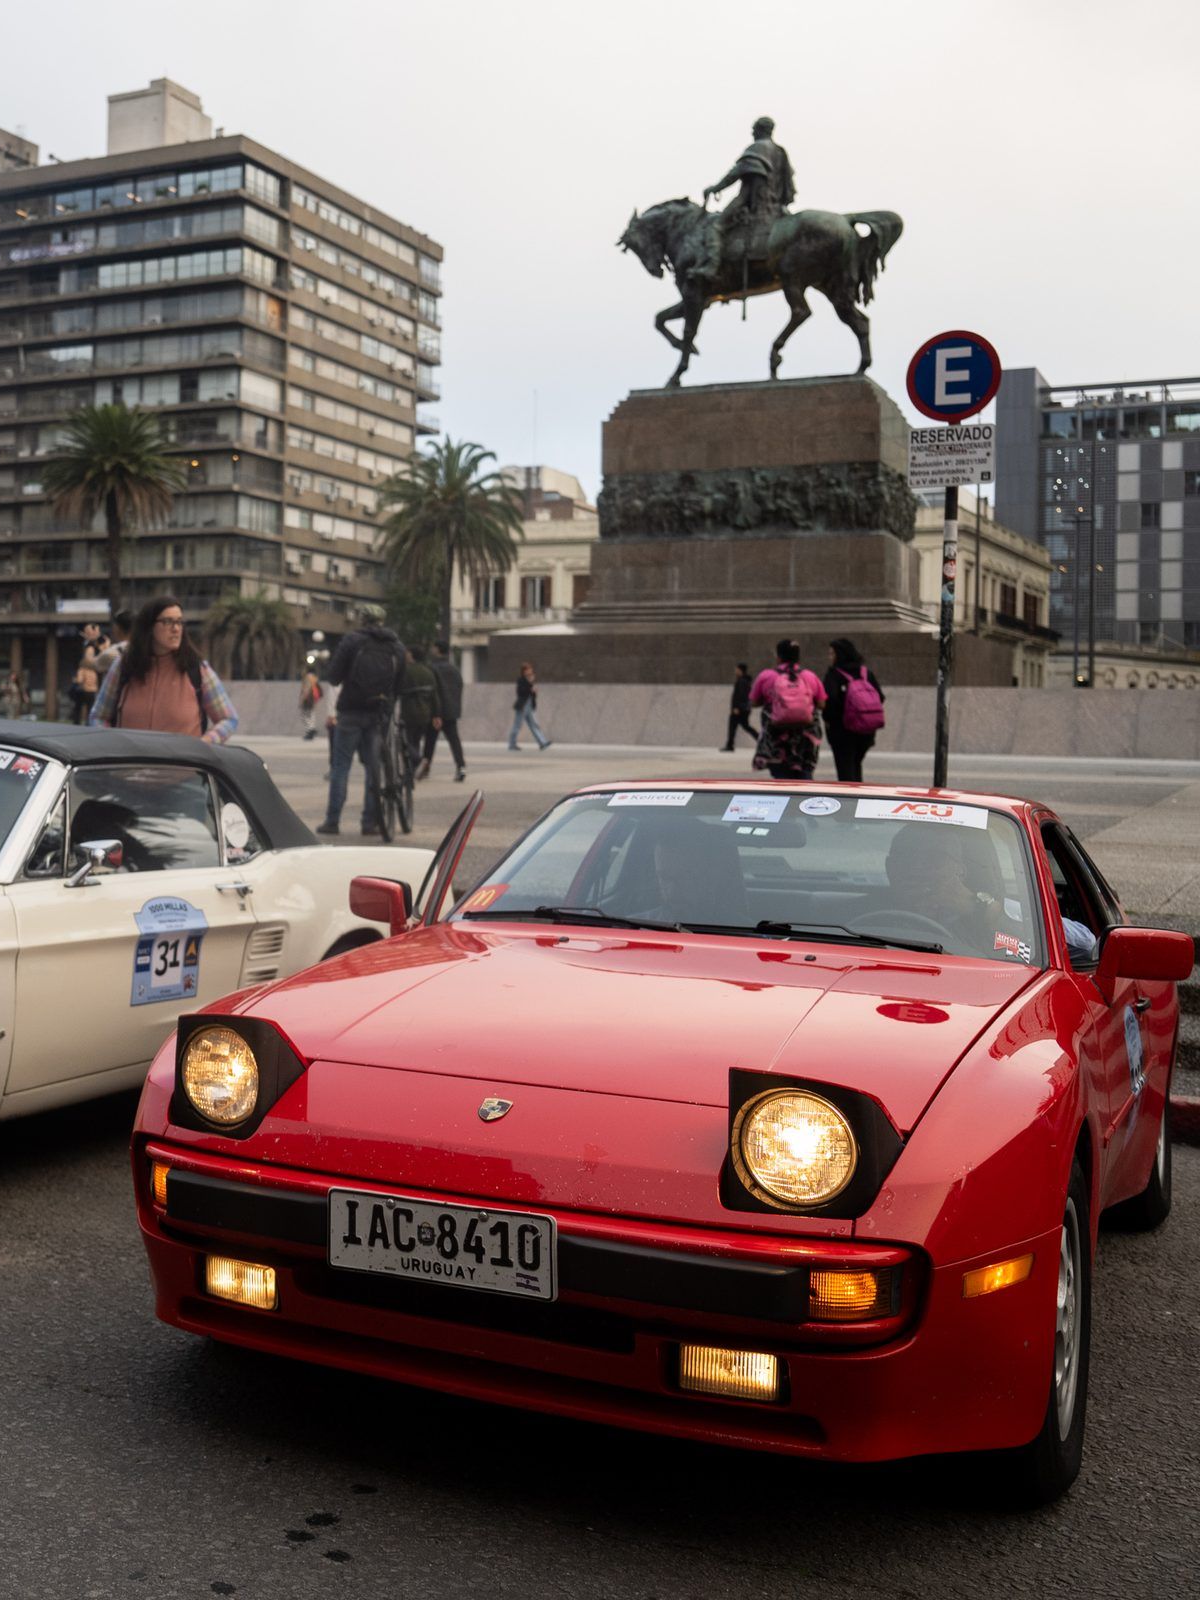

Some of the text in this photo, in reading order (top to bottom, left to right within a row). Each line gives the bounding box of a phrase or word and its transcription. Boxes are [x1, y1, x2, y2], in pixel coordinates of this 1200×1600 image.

[934, 346, 972, 406] E
[910, 426, 993, 444] RESERVADO
[163, 902, 188, 912] MILLAS
[154, 938, 180, 977] 31
[342, 1200, 542, 1272] IAC 8410
[400, 1257, 477, 1281] URUGUAY
